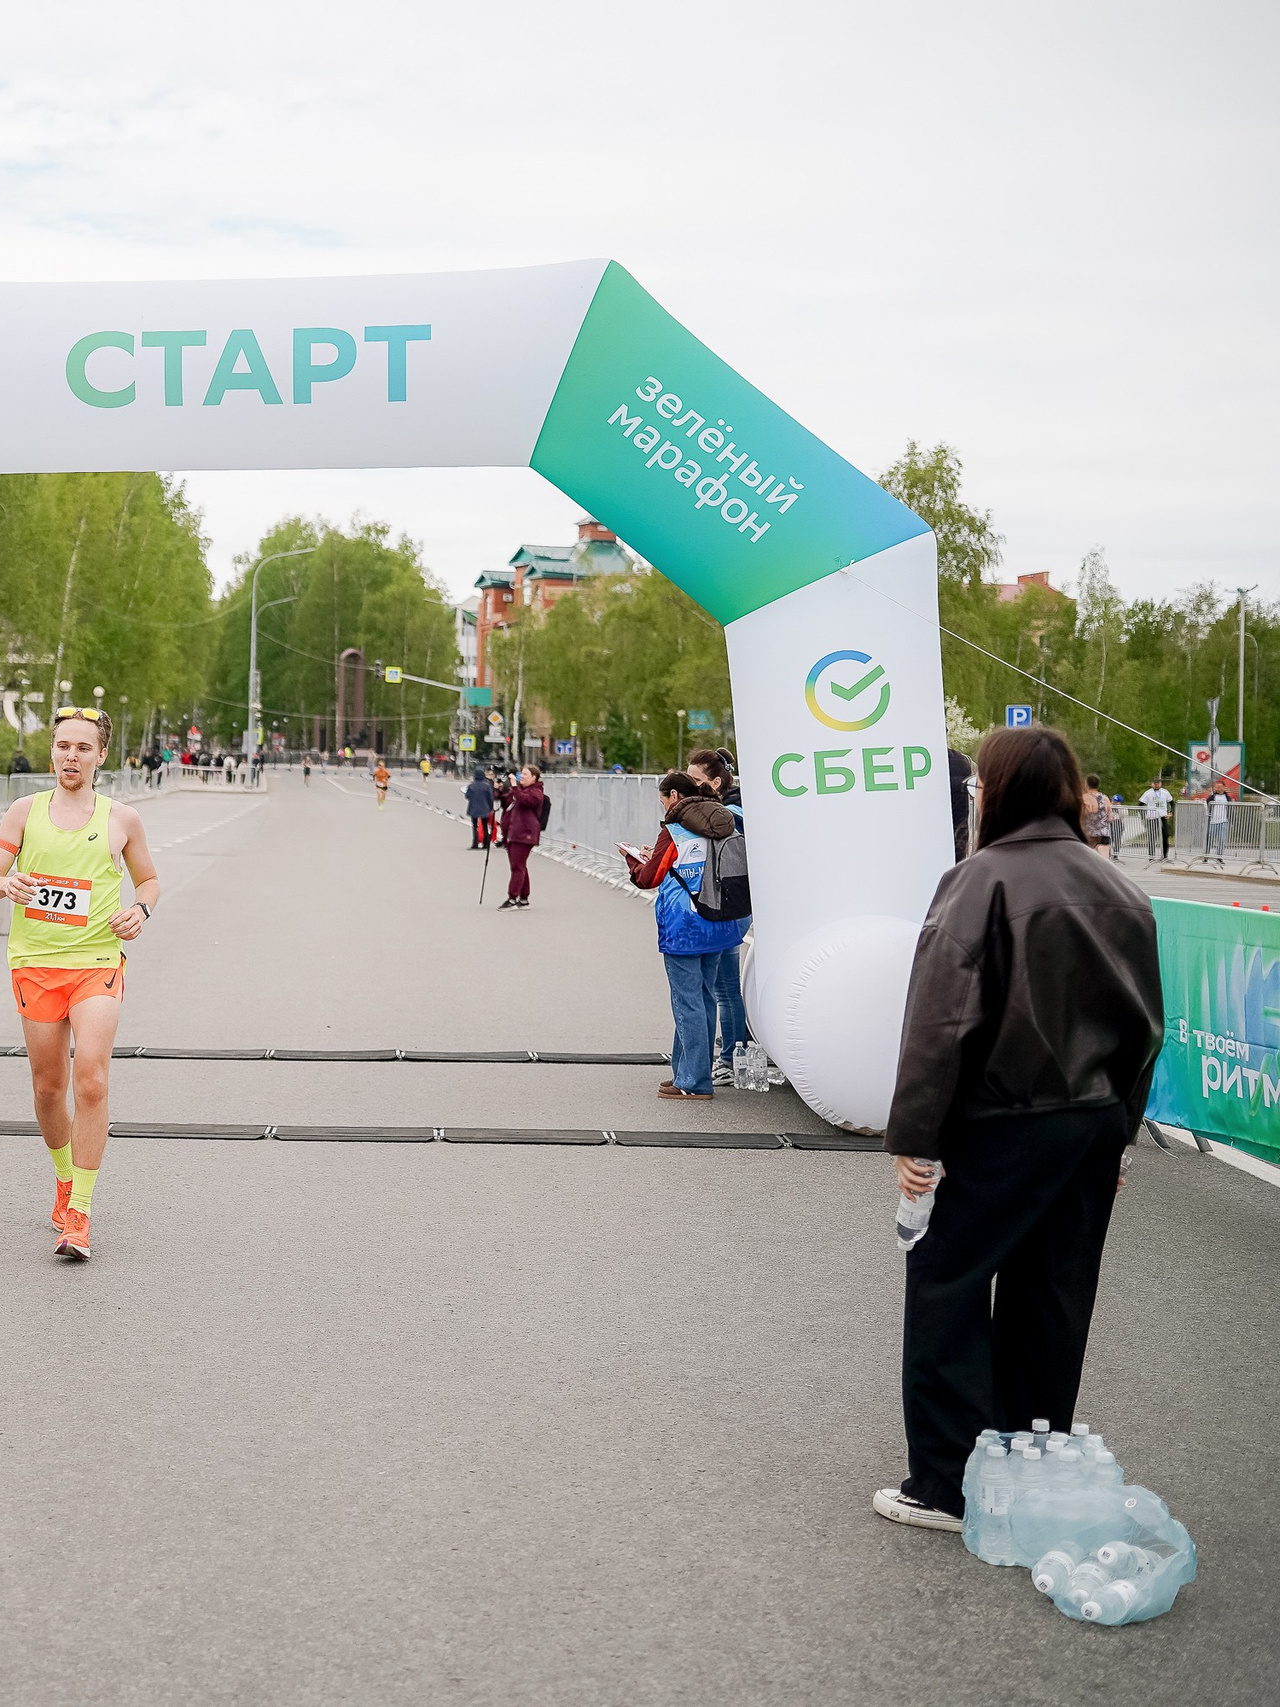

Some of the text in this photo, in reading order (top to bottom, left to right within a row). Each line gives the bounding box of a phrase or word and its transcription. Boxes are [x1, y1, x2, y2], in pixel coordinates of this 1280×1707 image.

[66, 324, 432, 409] СТАРТ
[635, 375, 805, 515] зелёный
[606, 403, 772, 544] марафон
[771, 746, 932, 798] СБЕР
[38, 888, 77, 910] 373
[1179, 1018, 1249, 1062] В твоём
[1201, 1054, 1280, 1109] ритм
